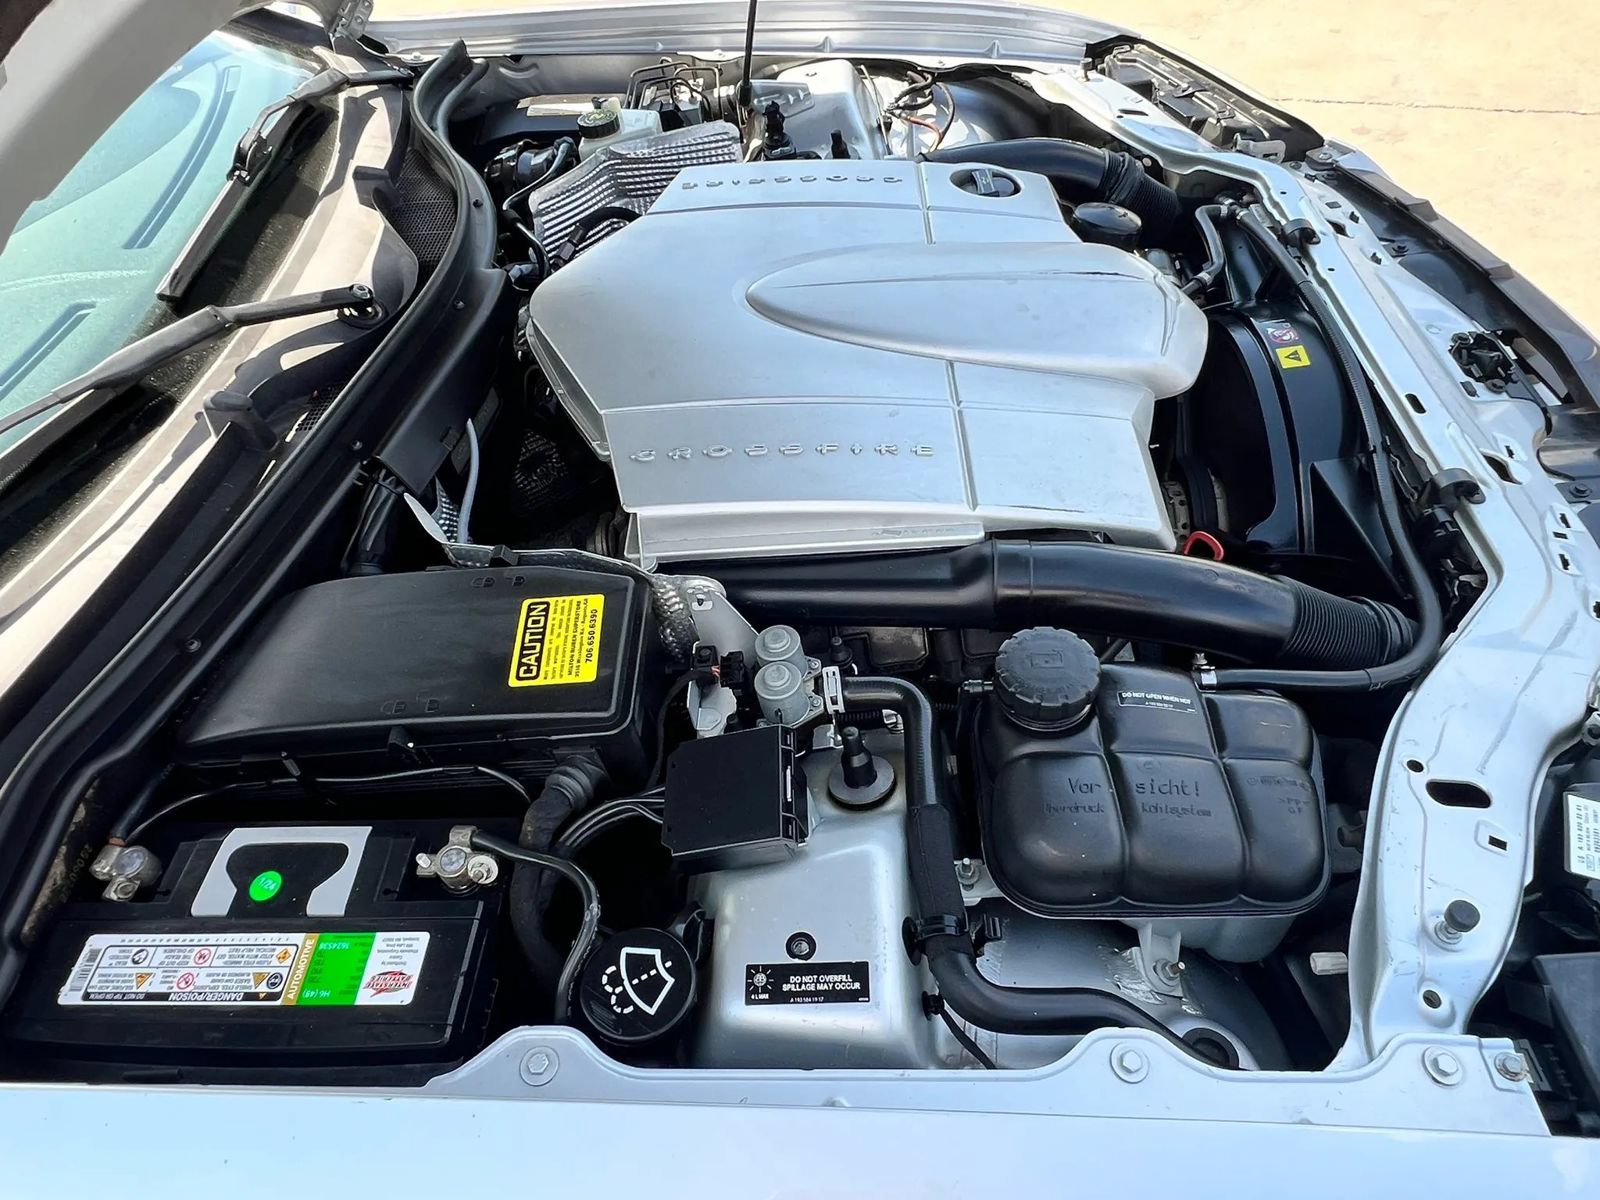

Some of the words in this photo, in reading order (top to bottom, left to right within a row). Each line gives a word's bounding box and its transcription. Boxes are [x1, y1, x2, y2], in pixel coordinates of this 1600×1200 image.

[629, 442, 935, 462] CROSSFIRE
[573, 601, 581, 633] SUPERSTORE
[519, 604, 547, 678] CAUTION
[585, 609, 598, 663] 706.650.6390
[1068, 778, 1101, 795] Vor
[1135, 778, 1200, 797] sicht!
[287, 939, 315, 1000] AUTOMOTIVE
[819, 974, 852, 982] OVERFILL
[364, 982, 411, 990] INTERSTATE
[782, 983, 815, 991] SPILLAGE
[835, 982, 860, 990] OCCUR
[168, 992, 244, 1001] DANGER/POISON
